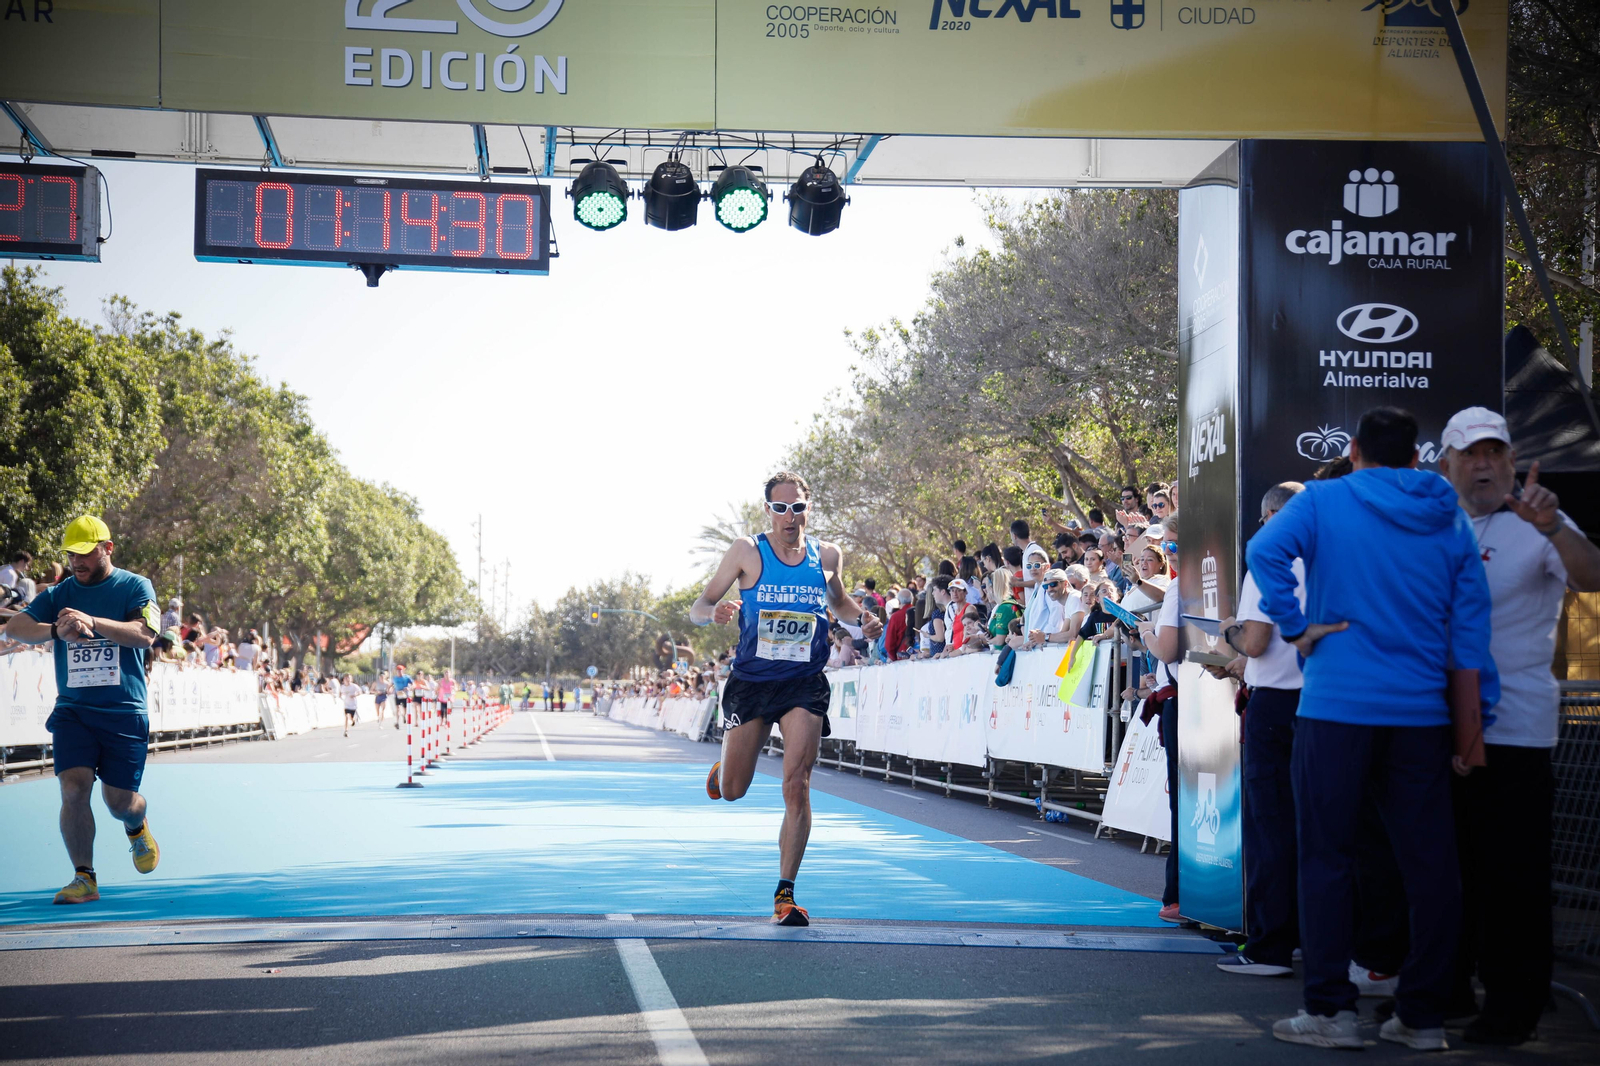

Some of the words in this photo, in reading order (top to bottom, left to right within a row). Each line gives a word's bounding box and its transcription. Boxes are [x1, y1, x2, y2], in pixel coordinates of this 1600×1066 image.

[766, 5, 897, 25] COOPERACIÓN
[1178, 7, 1256, 25] CIUDAD
[765, 23, 810, 38] 2005
[848, 25, 864, 33] ocio
[873, 26, 900, 34] cultura
[941, 21, 971, 30] 2020
[1372, 36, 1435, 47] DEPORTES
[344, 44, 567, 94] EDICIÓN
[1285, 220, 1457, 265] cajamar
[1368, 257, 1403, 269] CAJA
[1406, 258, 1452, 270] RURAL
[1319, 350, 1433, 369] HYUNDAI
[1323, 371, 1429, 389] Almerialva
[1188, 414, 1227, 478] NEXAL
[766, 619, 810, 636] 1504
[73, 648, 114, 663] 5879
